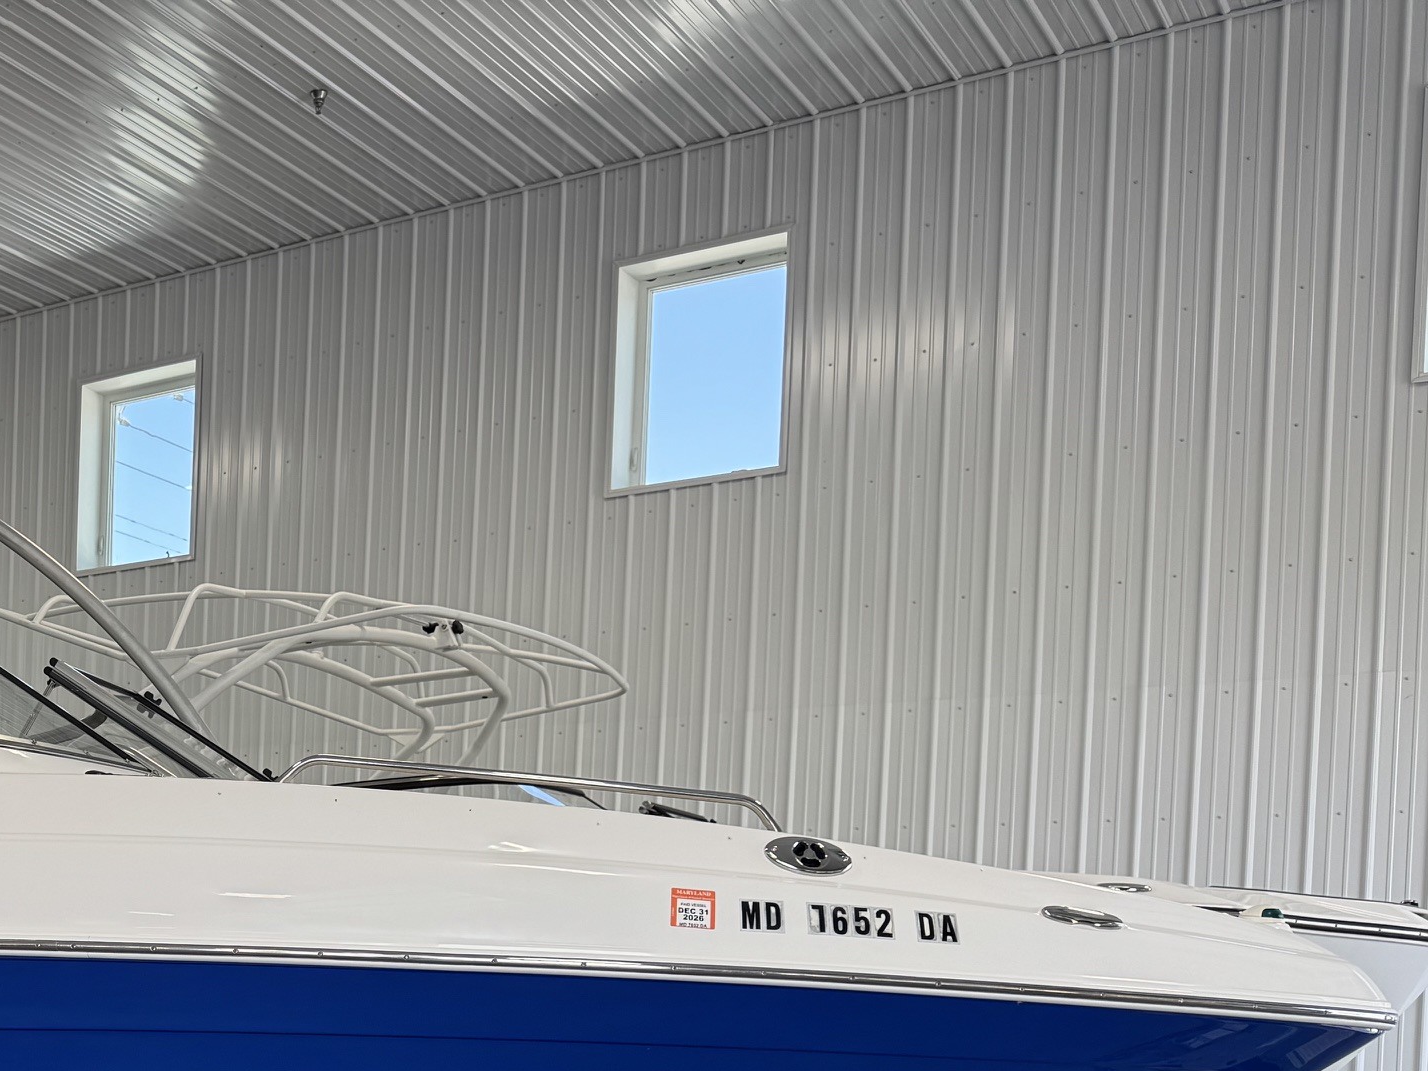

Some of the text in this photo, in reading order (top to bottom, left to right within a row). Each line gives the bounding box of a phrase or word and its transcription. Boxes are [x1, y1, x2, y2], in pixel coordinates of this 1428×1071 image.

[678, 907, 696, 915] DEC
[698, 908, 709, 916] 31
[683, 914, 704, 922] 2026
[741, 901, 958, 943] MD 1652 DA
